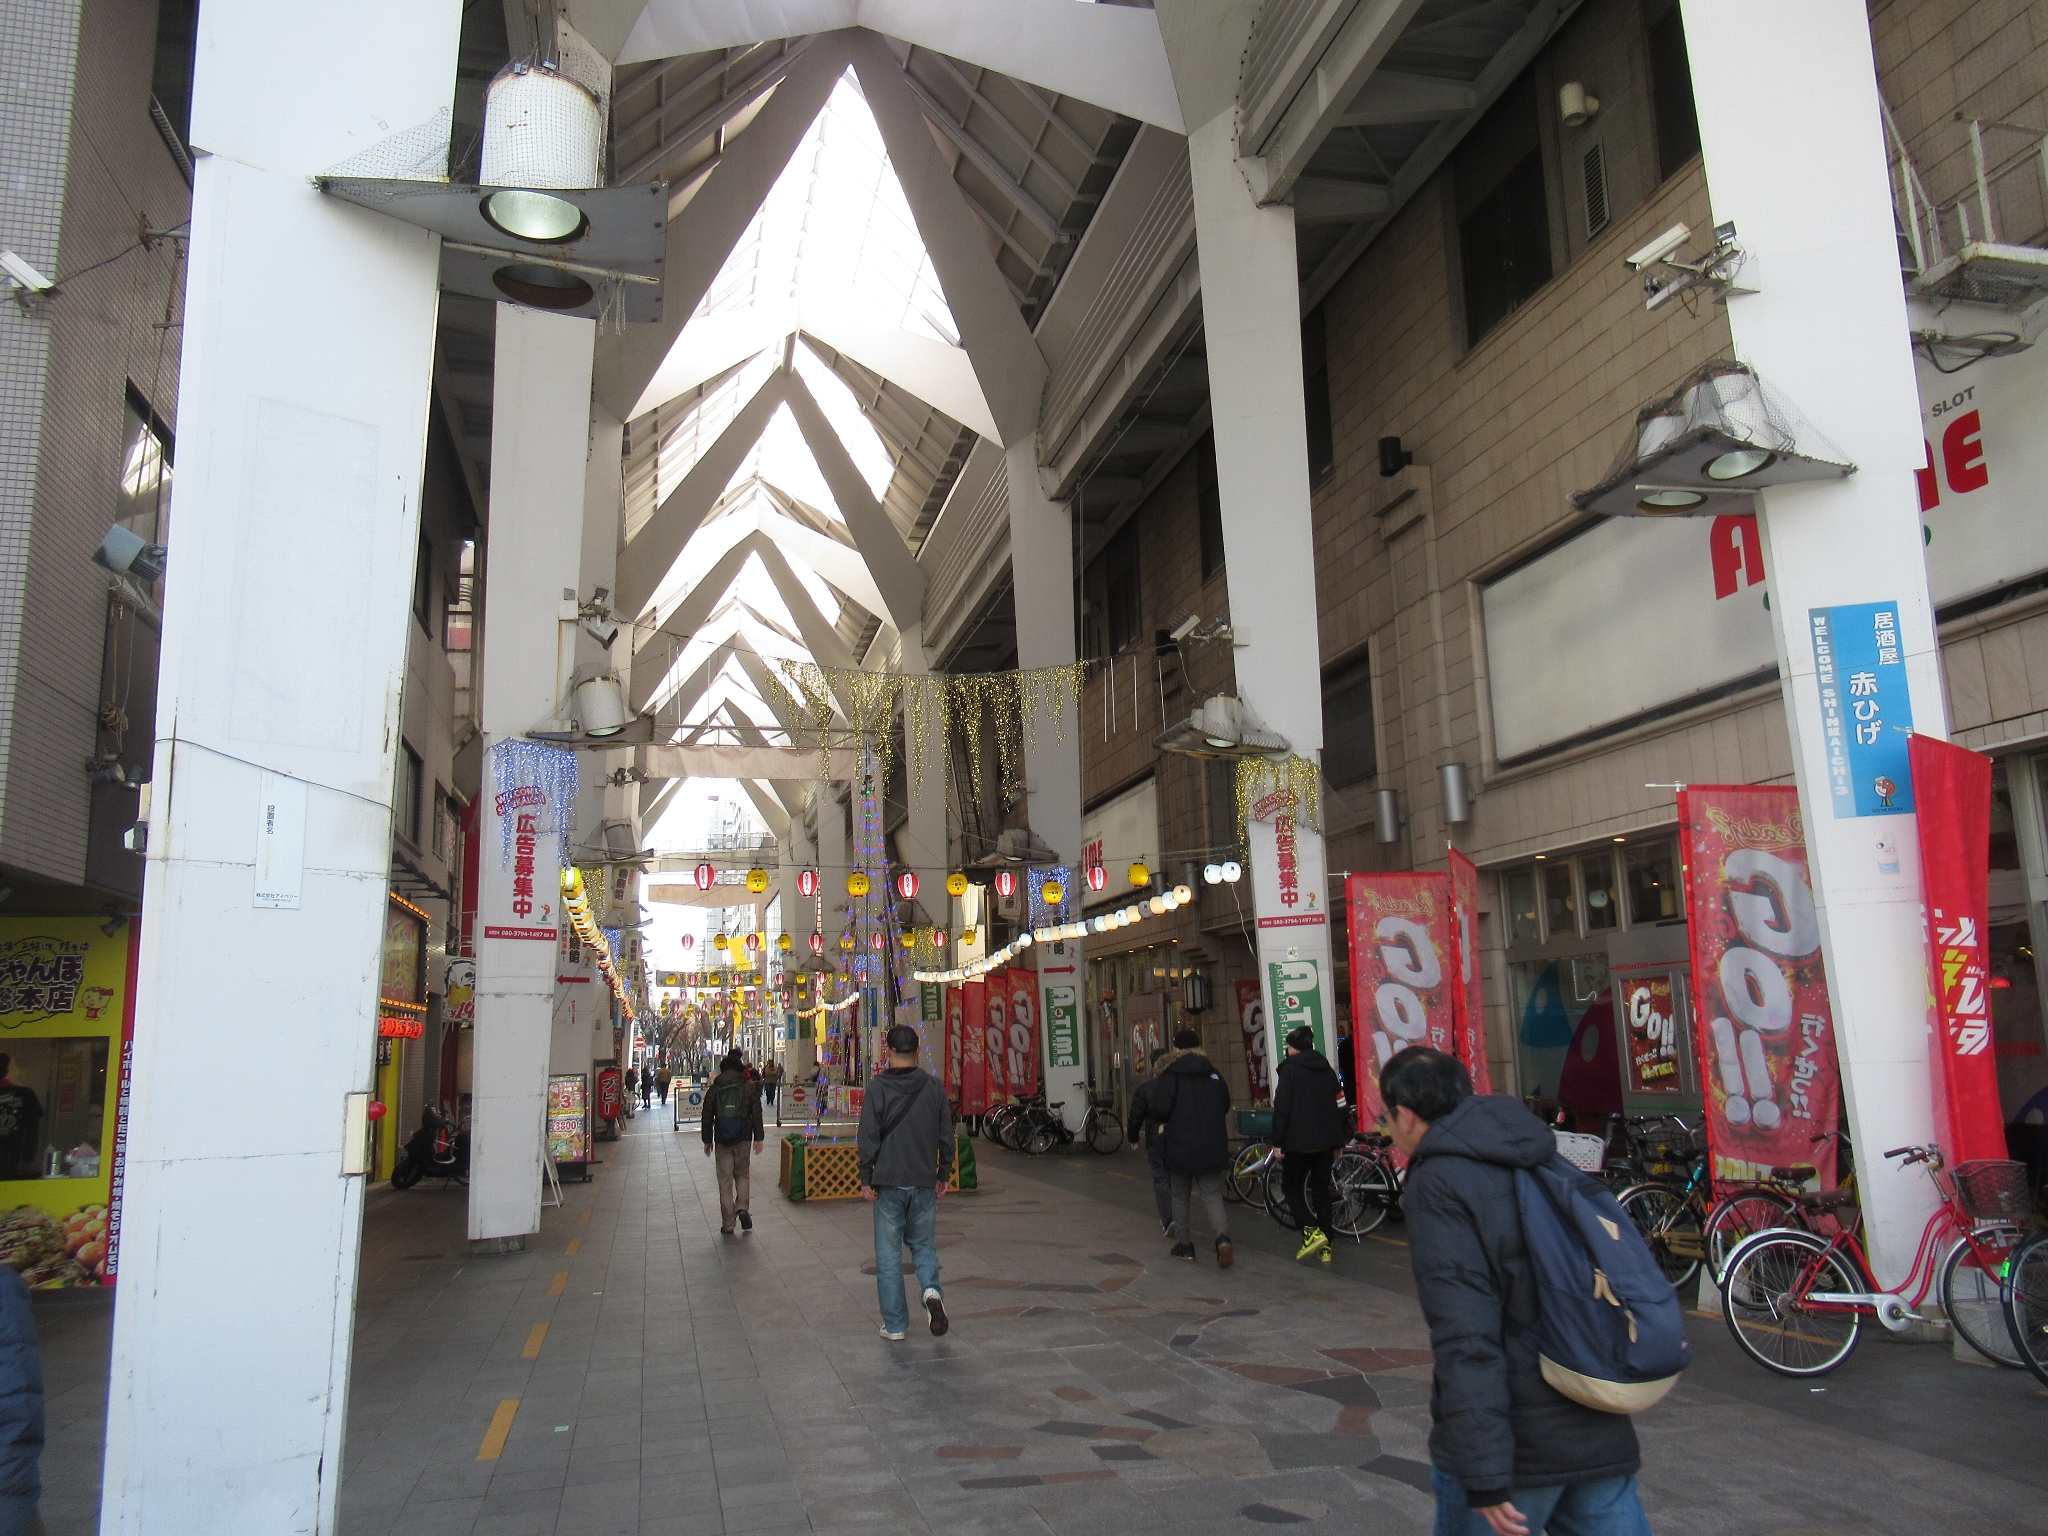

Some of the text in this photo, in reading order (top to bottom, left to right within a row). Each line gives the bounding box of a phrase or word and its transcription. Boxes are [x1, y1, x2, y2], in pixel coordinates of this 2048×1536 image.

[1931, 385, 1975, 418] SLOT
[1813, 617, 1834, 684] WELCOME
[1874, 611, 1899, 665] 居酒屋
[1849, 671, 1883, 745] 赤ひげ
[512, 813, 536, 919] 広告募集中
[1275, 815, 1299, 908] 広告募集中
